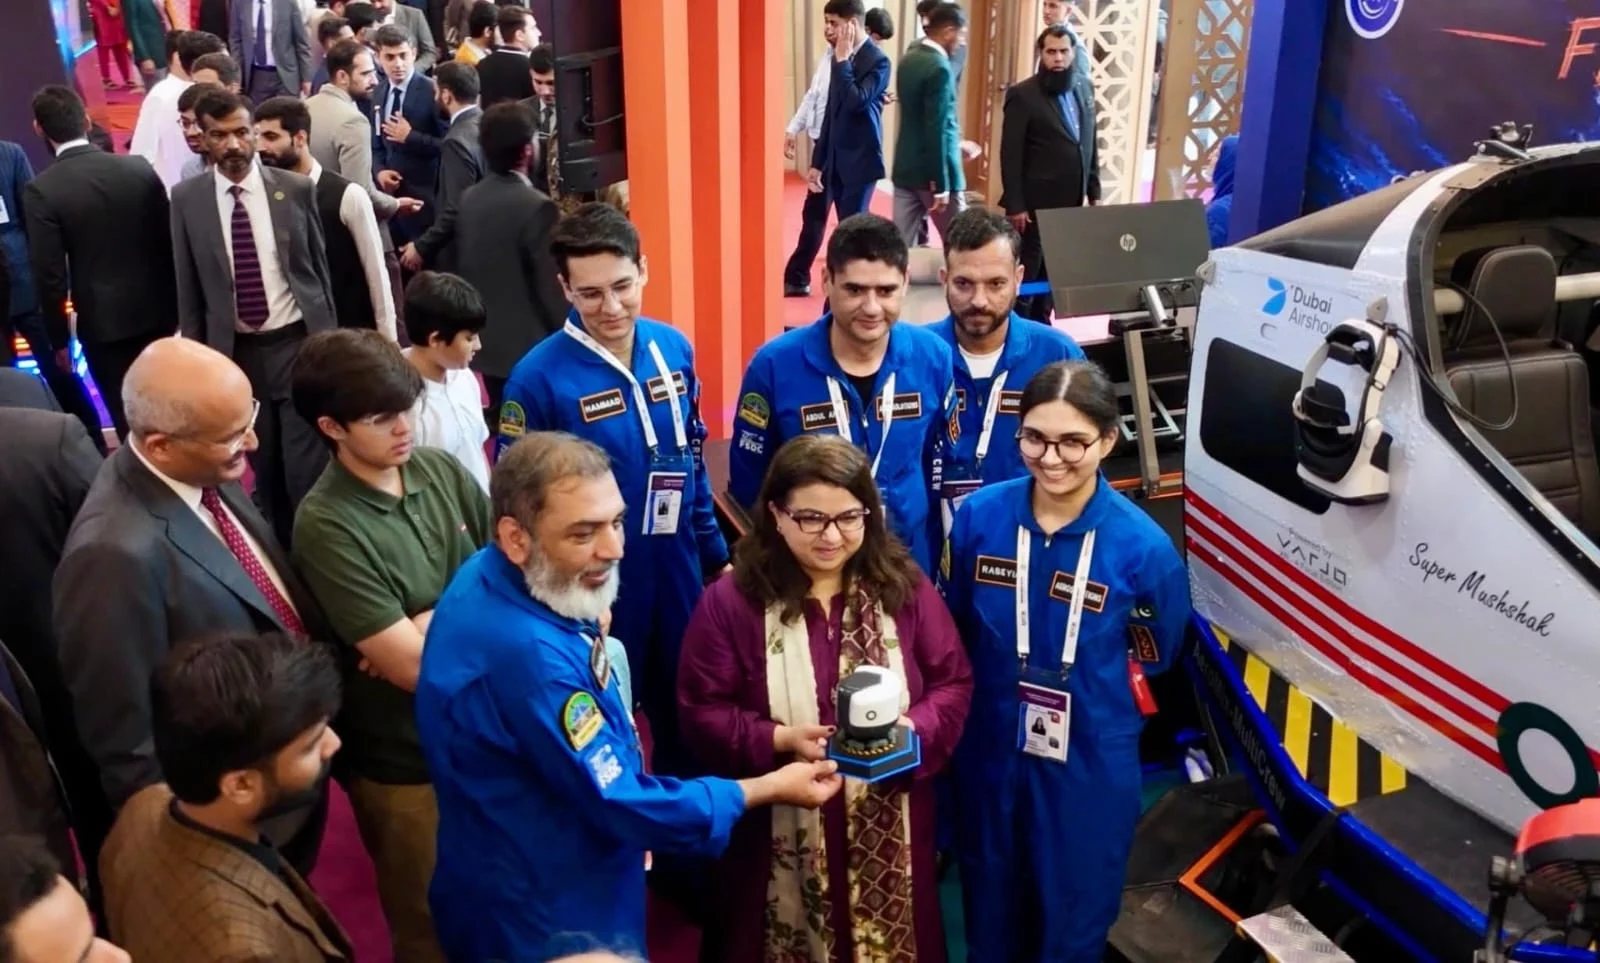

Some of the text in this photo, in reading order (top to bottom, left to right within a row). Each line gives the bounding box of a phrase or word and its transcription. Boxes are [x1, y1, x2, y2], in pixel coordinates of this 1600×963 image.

[1293, 286, 1333, 314] Dubai
[1288, 307, 1335, 334] Airsho
[932, 458, 943, 490] CREW
[1408, 542, 1457, 583] Super
[1457, 570, 1556, 637] Mushshak
